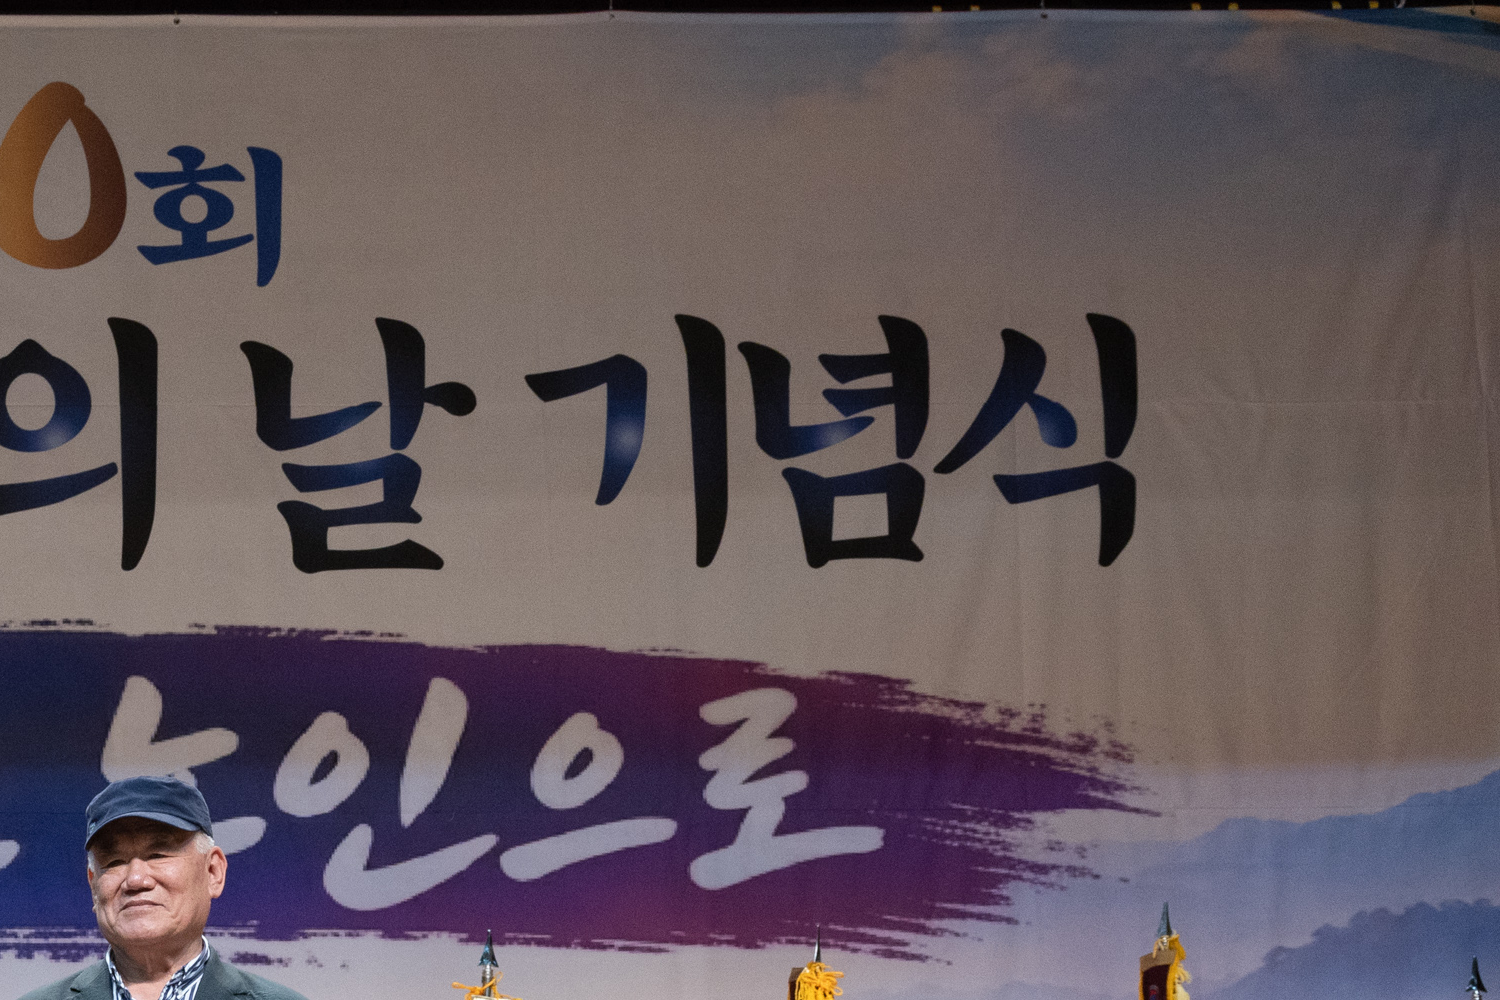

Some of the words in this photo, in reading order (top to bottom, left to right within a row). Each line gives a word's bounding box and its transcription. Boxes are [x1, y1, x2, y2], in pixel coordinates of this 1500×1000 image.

[240, 316, 478, 574] 날
[523, 312, 1139, 569] 기념식
[102, 674, 885, 911] 노인으로
